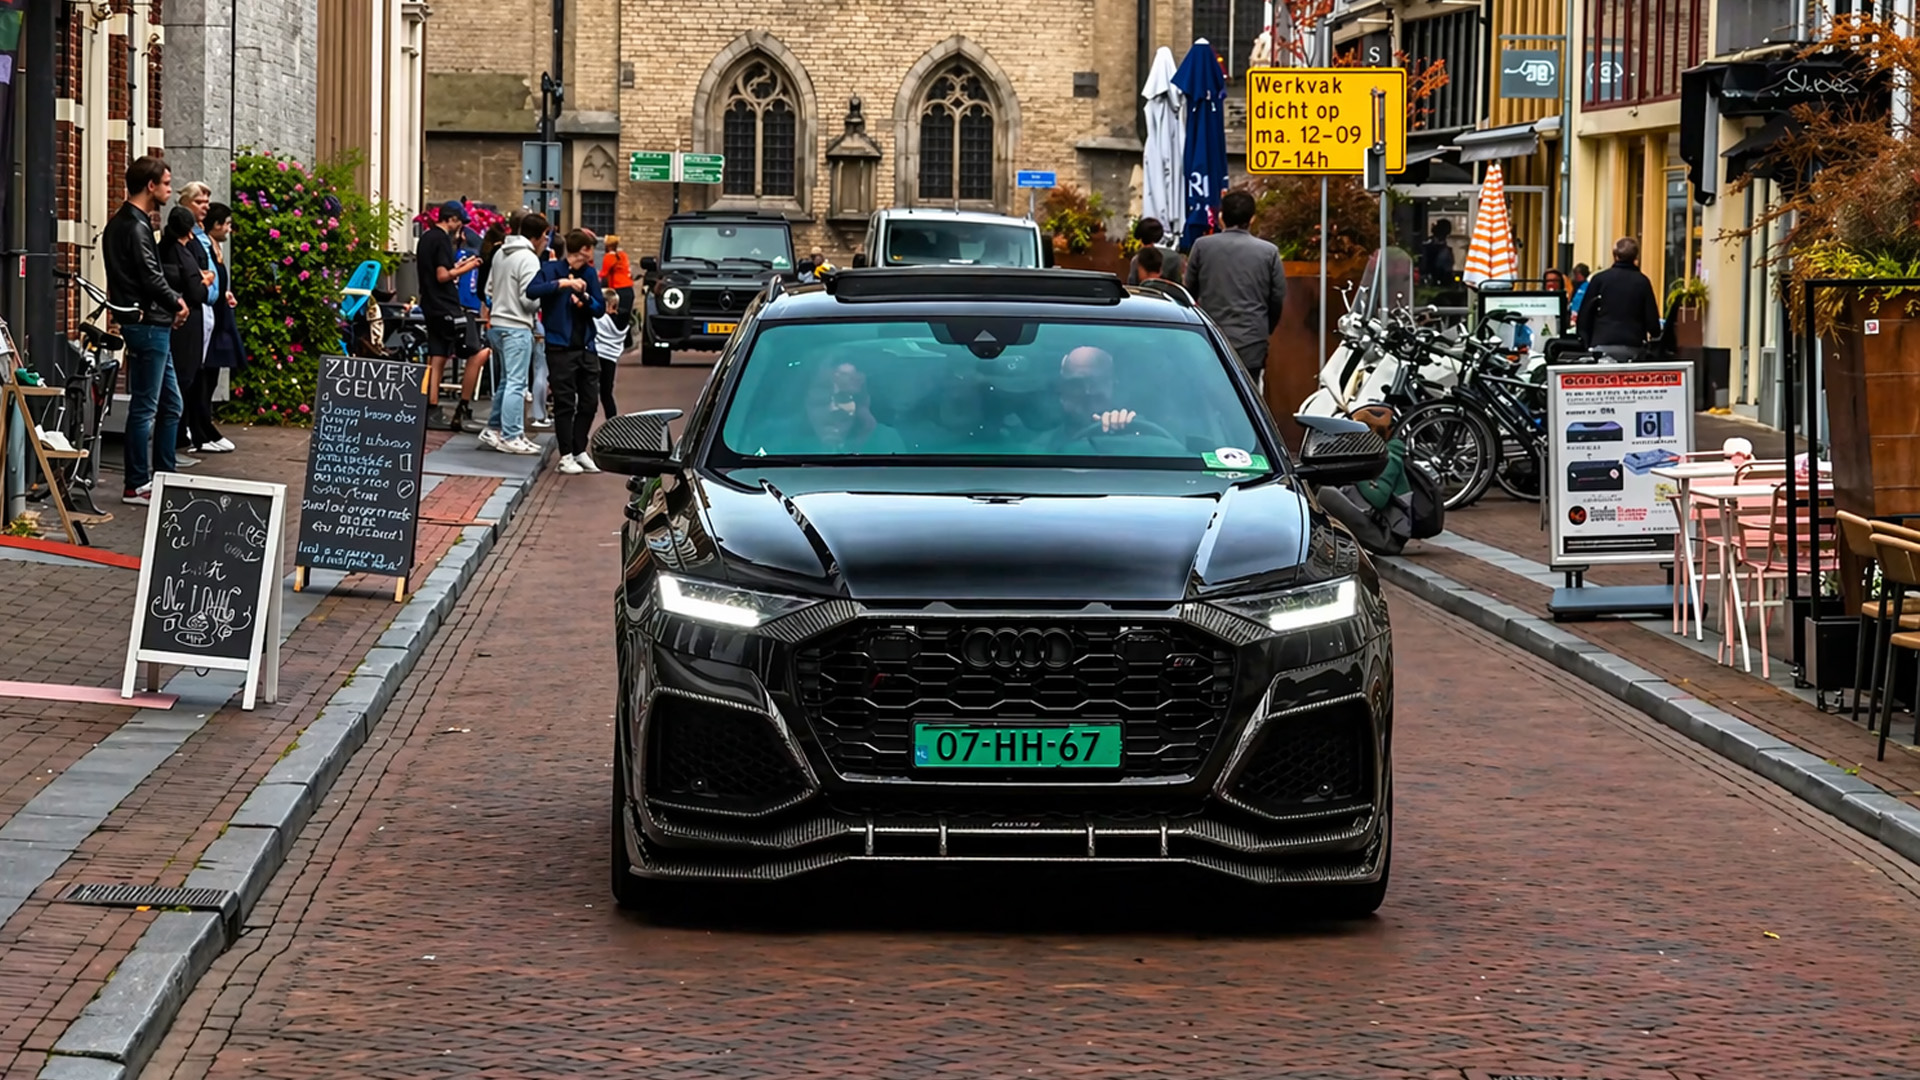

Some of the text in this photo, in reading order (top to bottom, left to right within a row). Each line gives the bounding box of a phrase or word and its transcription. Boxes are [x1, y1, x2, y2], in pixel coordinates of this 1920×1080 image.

[1255, 76, 1343, 94] Werkvak
[1255, 101, 1340, 122] dicht op
[1255, 125, 1362, 144] ma. 12-09
[1255, 150, 1329, 168] 07-14h
[325, 358, 417, 388] ZUIVER
[936, 731, 1100, 762] 07-HH-67
